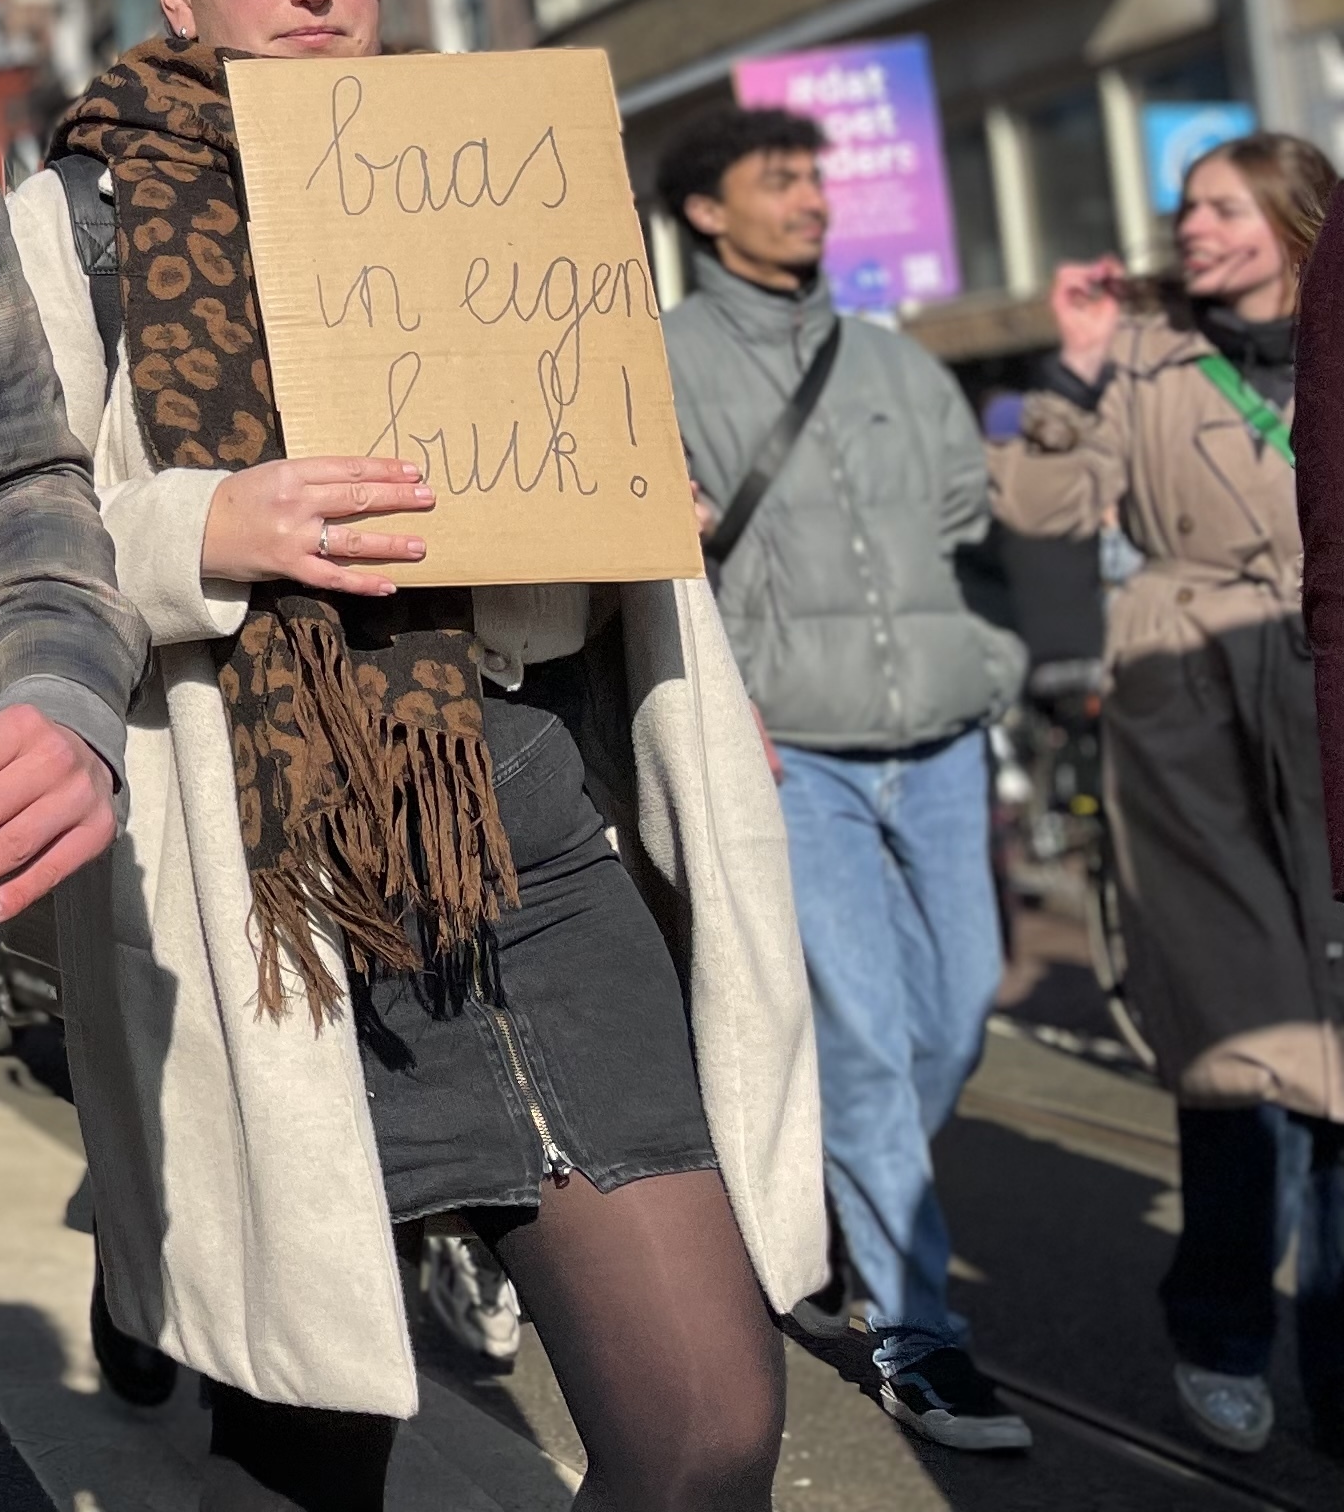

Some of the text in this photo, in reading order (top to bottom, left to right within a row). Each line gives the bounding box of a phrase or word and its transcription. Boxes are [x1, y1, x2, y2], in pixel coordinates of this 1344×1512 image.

[306, 75, 567, 215] baas
[316, 256, 660, 406] in eigen
